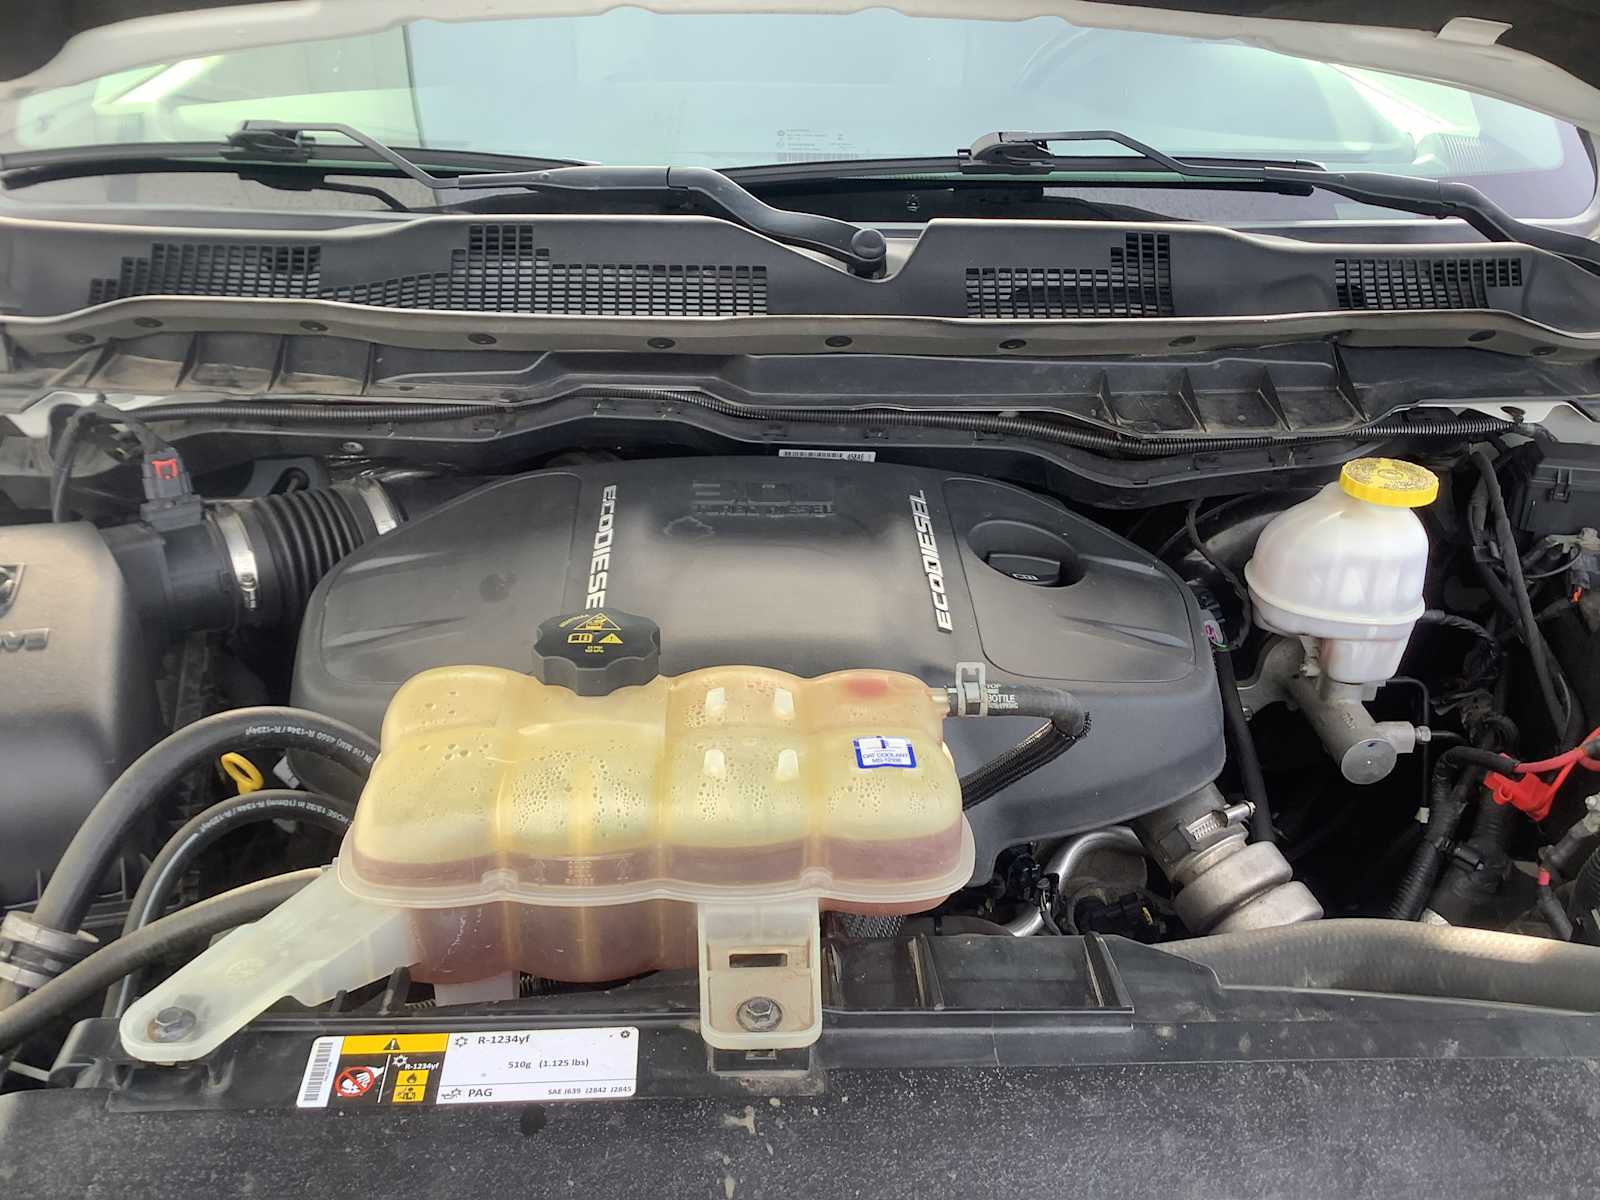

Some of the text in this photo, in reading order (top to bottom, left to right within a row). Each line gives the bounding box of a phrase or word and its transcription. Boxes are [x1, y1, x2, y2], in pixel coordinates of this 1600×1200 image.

[585, 484, 617, 610] ECODIESE
[908, 489, 953, 633] ECODIESEL
[477, 1034, 531, 1046] R-1234yf
[404, 1061, 440, 1071] R-1234yf
[507, 1058, 590, 1070] 510g (1.125 lbs)
[467, 1088, 493, 1098] PAG
[547, 1085, 632, 1096] SAE J639 J2842 J2845
